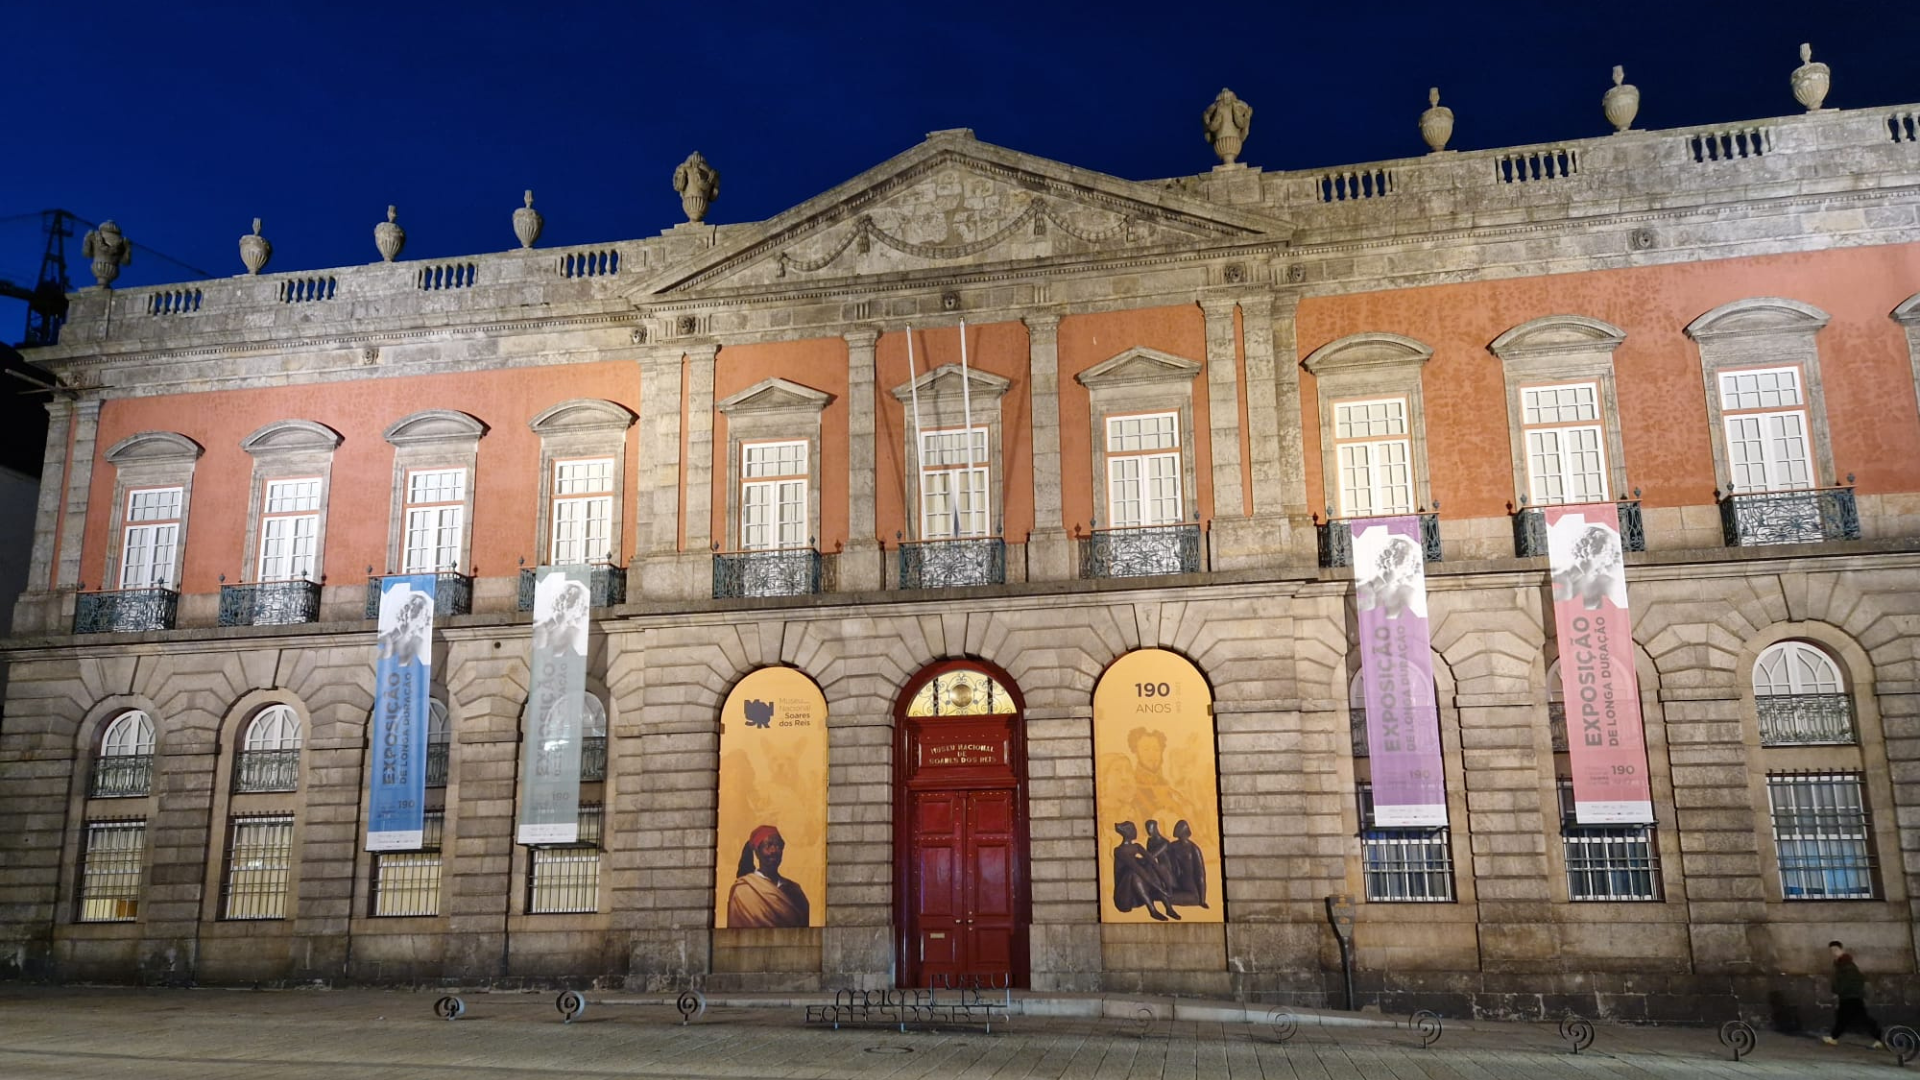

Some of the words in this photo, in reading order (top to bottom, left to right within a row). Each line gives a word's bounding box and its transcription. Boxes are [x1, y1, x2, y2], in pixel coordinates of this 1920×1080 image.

[1396, 625, 1411, 685] DURAÇÃO
[1595, 616, 1611, 678] DURAÇÃO
[1135, 682, 1170, 698] 190
[1372, 626, 1401, 752] EXPOSIÇÃO
[1570, 616, 1602, 747] EXPOSIÇÃO
[402, 672, 412, 726] DURAÇÃO
[1135, 703, 1172, 714] ANOS
[1401, 691, 1415, 729] LONGA
[1602, 682, 1616, 726] LONGA
[382, 672, 400, 785] EXPOSIÇÃO
[1608, 731, 1619, 746] DE
[400, 728, 409, 766] LONGA
[930, 744, 956, 755] MUSEU
[958, 743, 994, 753] NACIONAL
[1406, 735, 1416, 752] DE
[961, 756, 977, 764] DOS
[1611, 765, 1635, 775] 190
[399, 767, 408, 784] DE
[398, 800, 415, 809] 190
